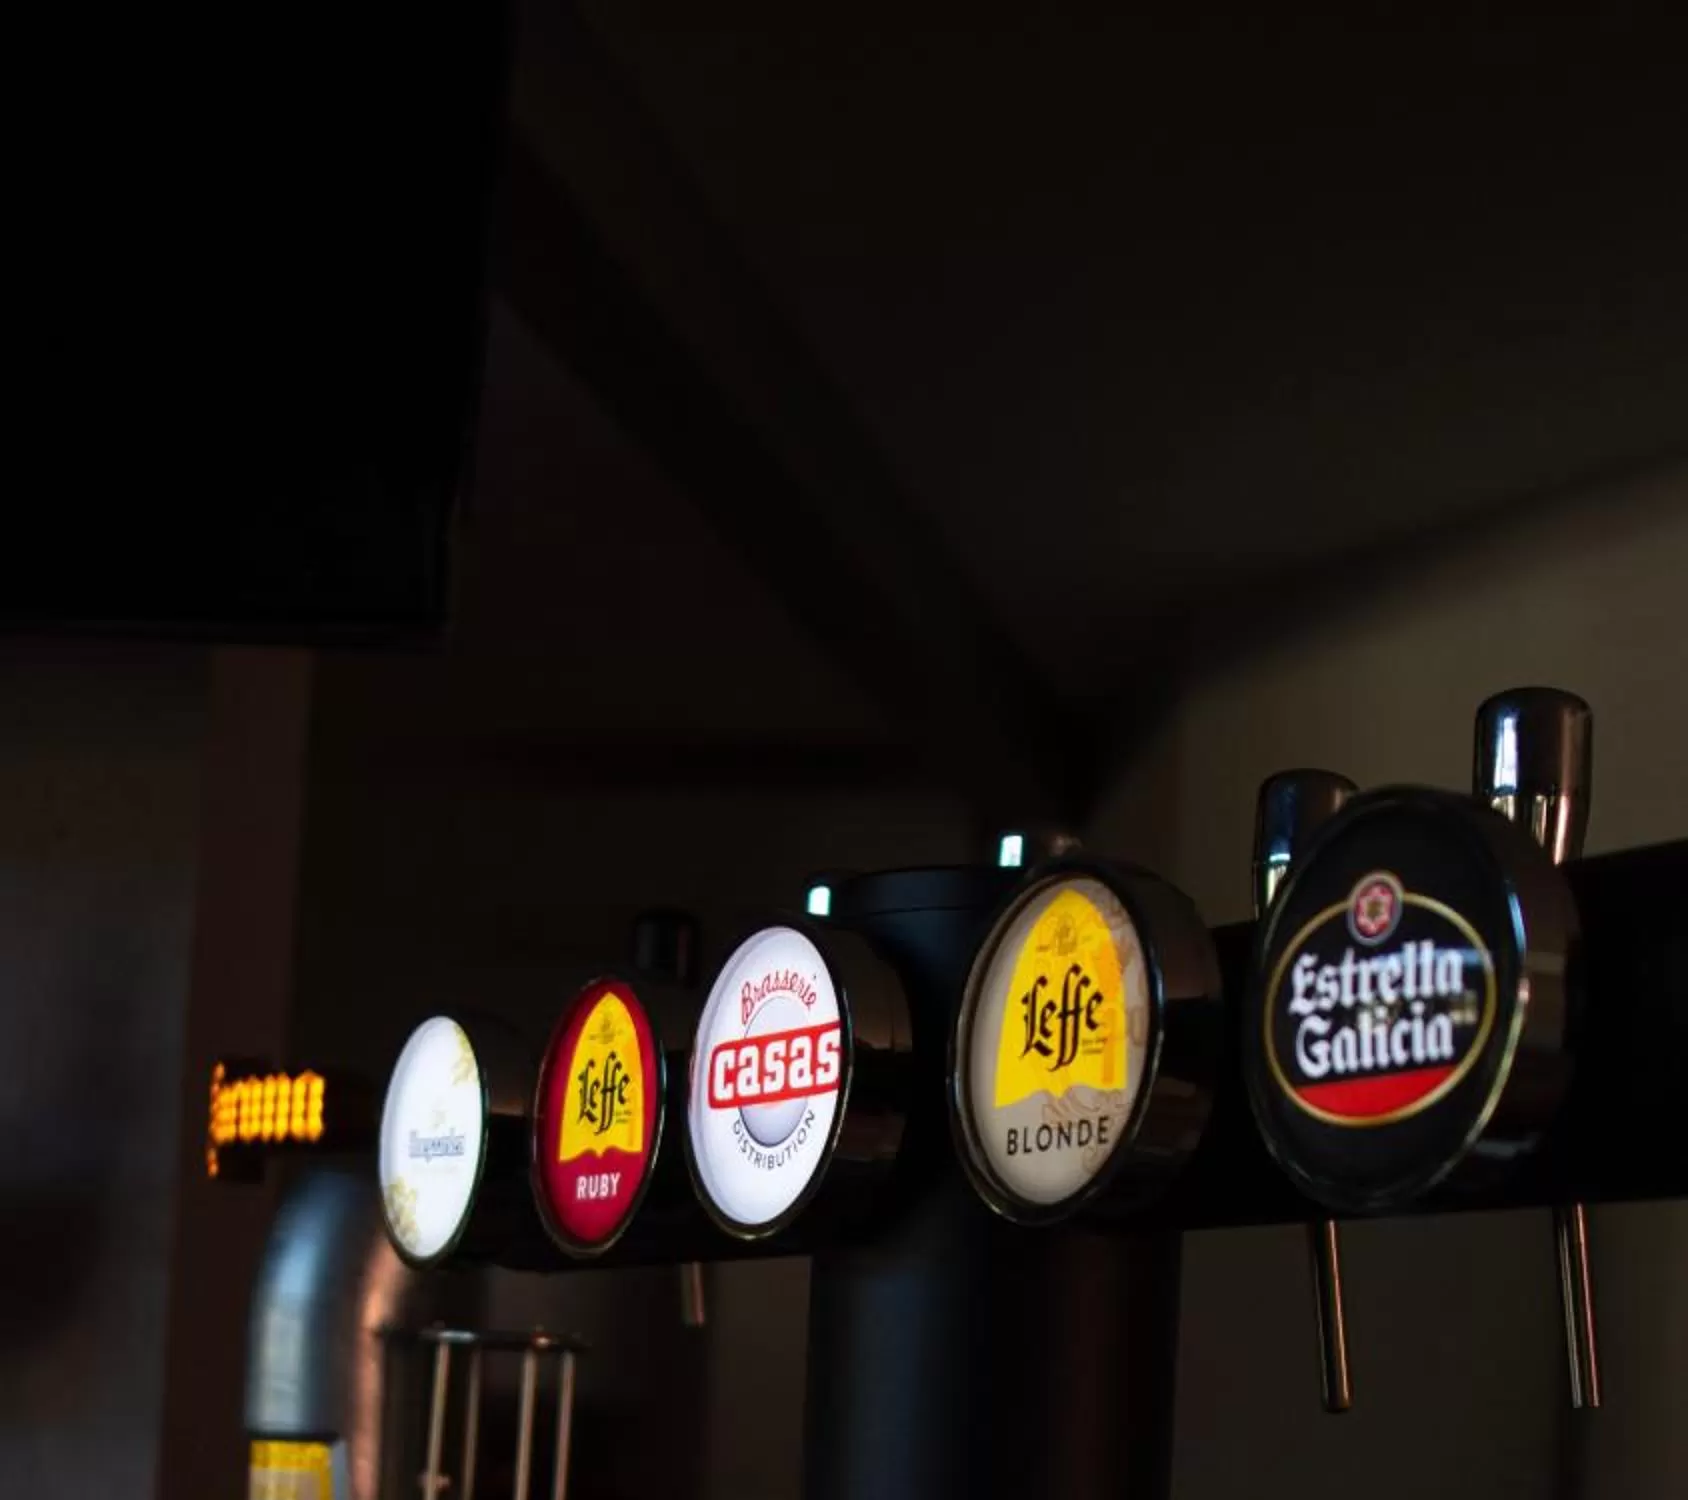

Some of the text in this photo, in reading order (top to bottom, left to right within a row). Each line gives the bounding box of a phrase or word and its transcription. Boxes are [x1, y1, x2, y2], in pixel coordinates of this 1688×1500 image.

[741, 968, 817, 1025] Brasserie
[1289, 939, 1465, 1015] Estrella
[1020, 963, 1104, 1072] Leffe
[1296, 1001, 1455, 1078] Galicia
[577, 1050, 630, 1135] Leffe
[733, 1109, 815, 1171] DISTRIBUTION
[1006, 1115, 1110, 1156] BLONDE
[576, 1172, 621, 1200] RUBY
